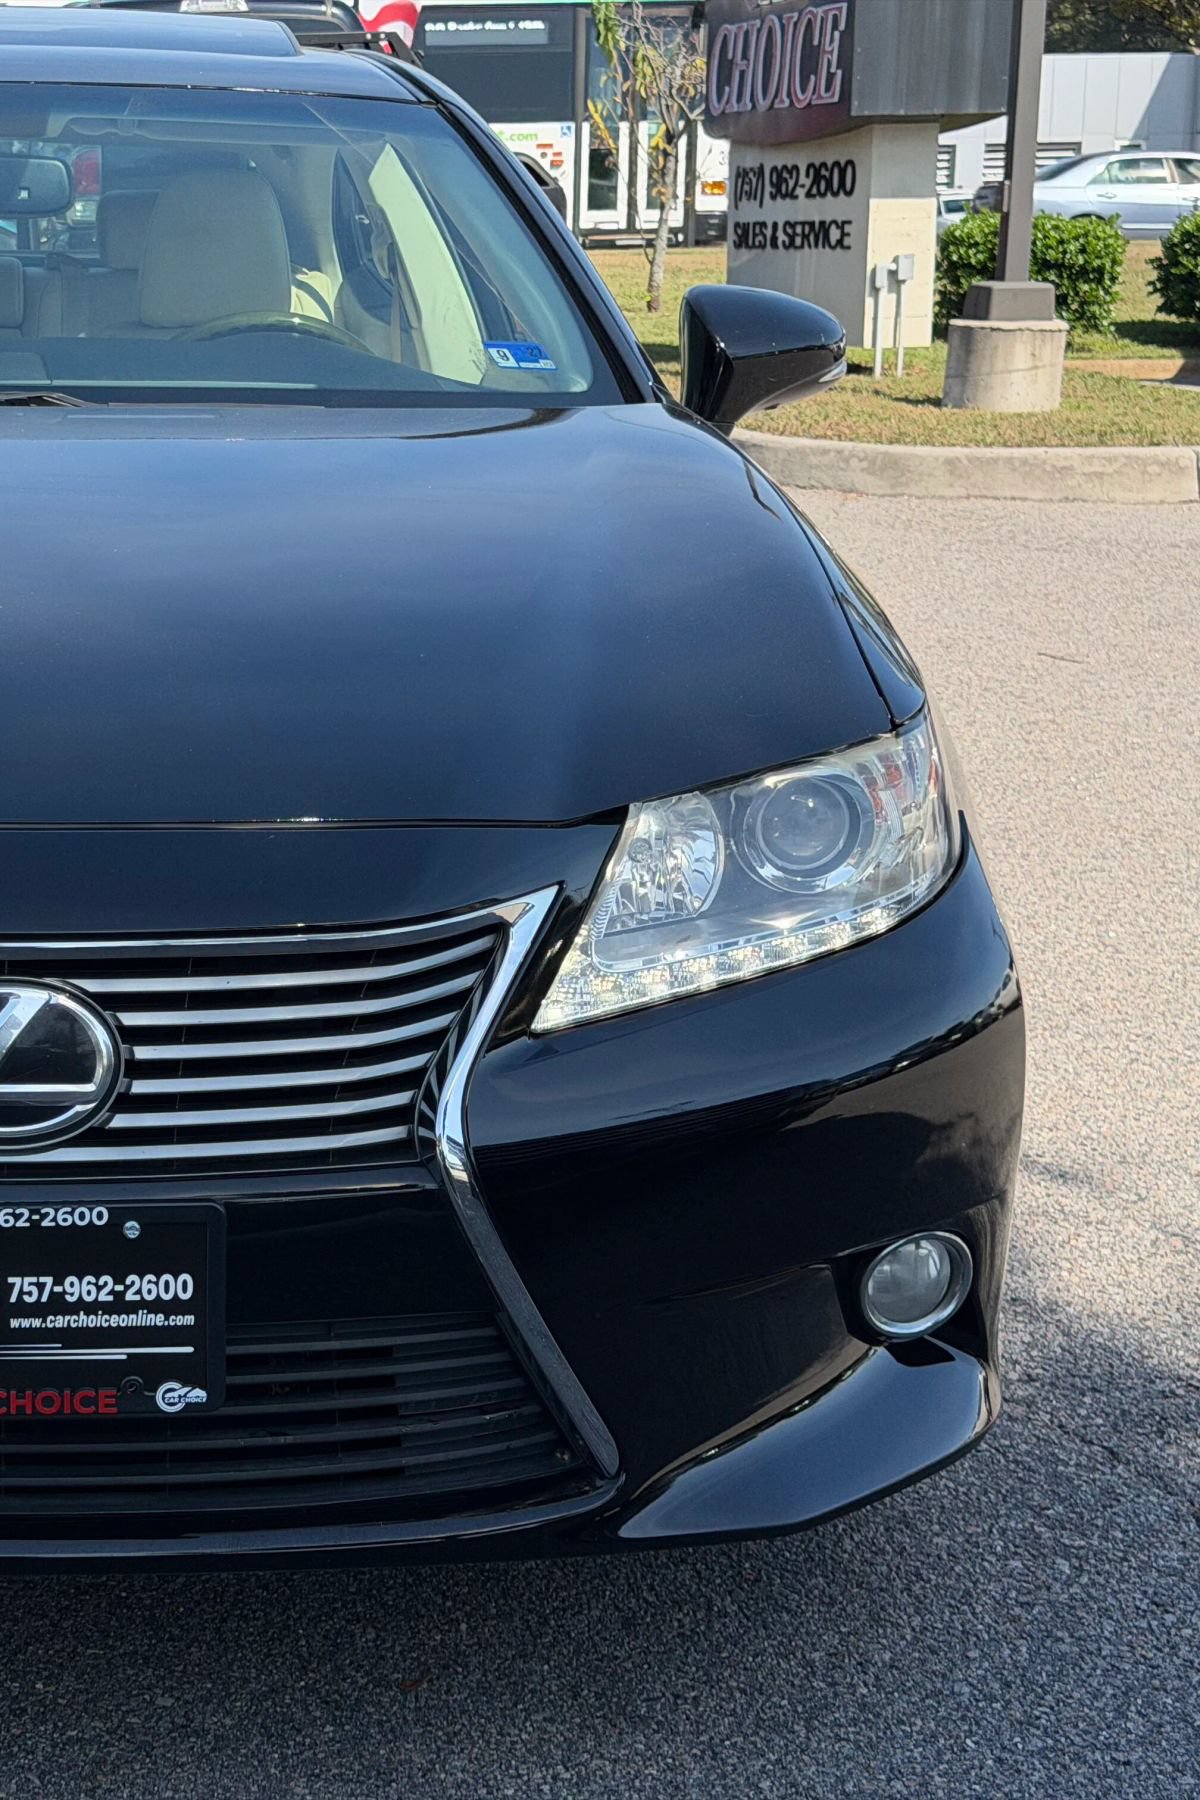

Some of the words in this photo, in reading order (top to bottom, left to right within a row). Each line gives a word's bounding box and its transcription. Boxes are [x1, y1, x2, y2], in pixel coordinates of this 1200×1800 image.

[708, 2, 848, 117] CHOICE
[733, 162, 766, 210] (757)
[769, 159, 856, 201] 962-2600
[733, 220, 768, 250] SALES
[770, 220, 779, 250] &
[782, 219, 852, 250] SERVICE
[7, 1273, 194, 1303] 757-962-2600
[9, 1309, 195, 1328] www.carchoiceonline.com
